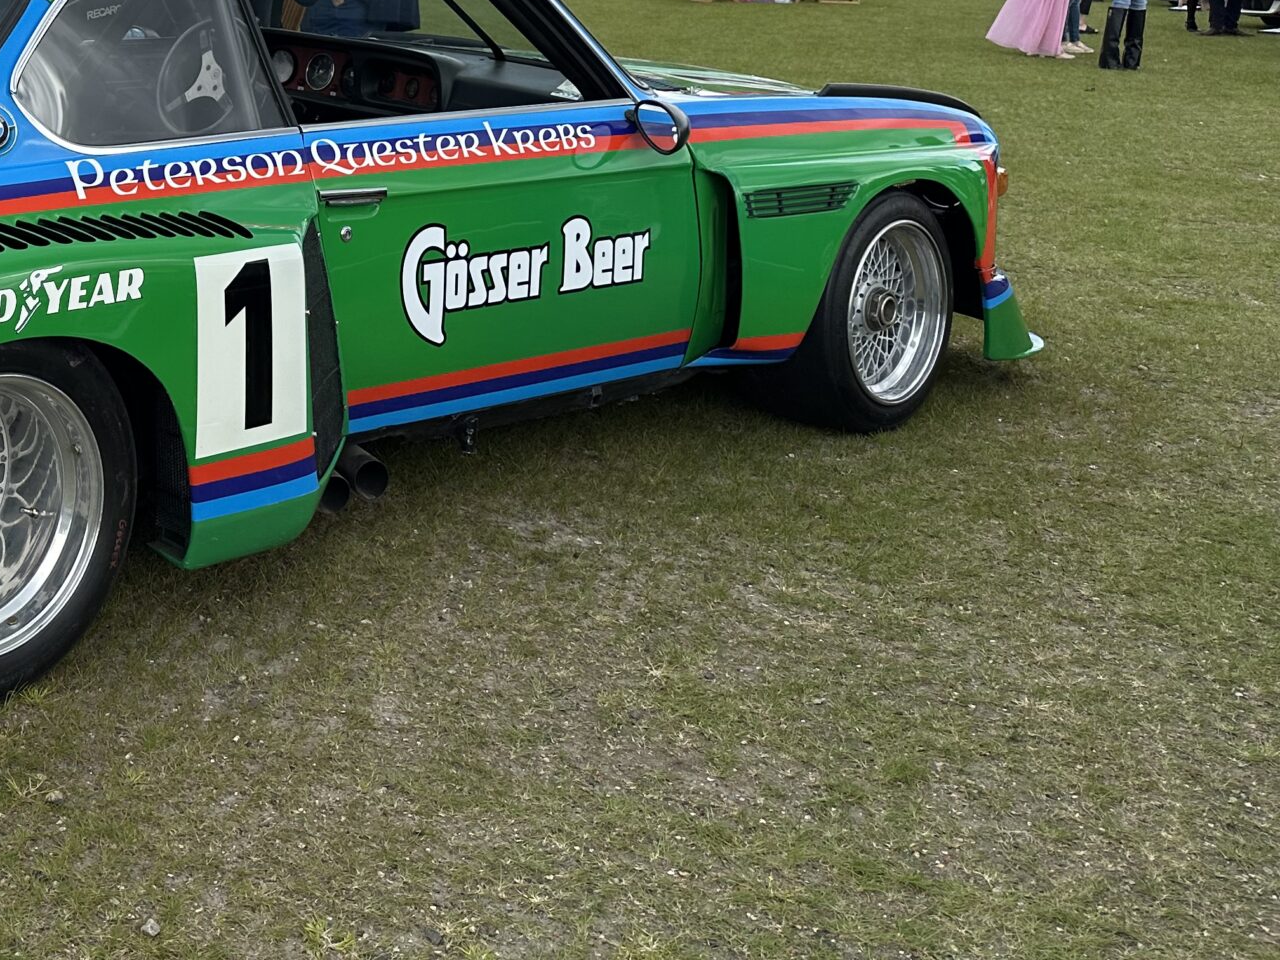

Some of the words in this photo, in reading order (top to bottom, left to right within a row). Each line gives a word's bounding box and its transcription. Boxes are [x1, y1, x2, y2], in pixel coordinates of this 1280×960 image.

[86, 4, 122, 21] RECAR
[224, 258, 273, 430] 1
[401, 224, 549, 347] Gösser
[558, 216, 650, 293] Beer
